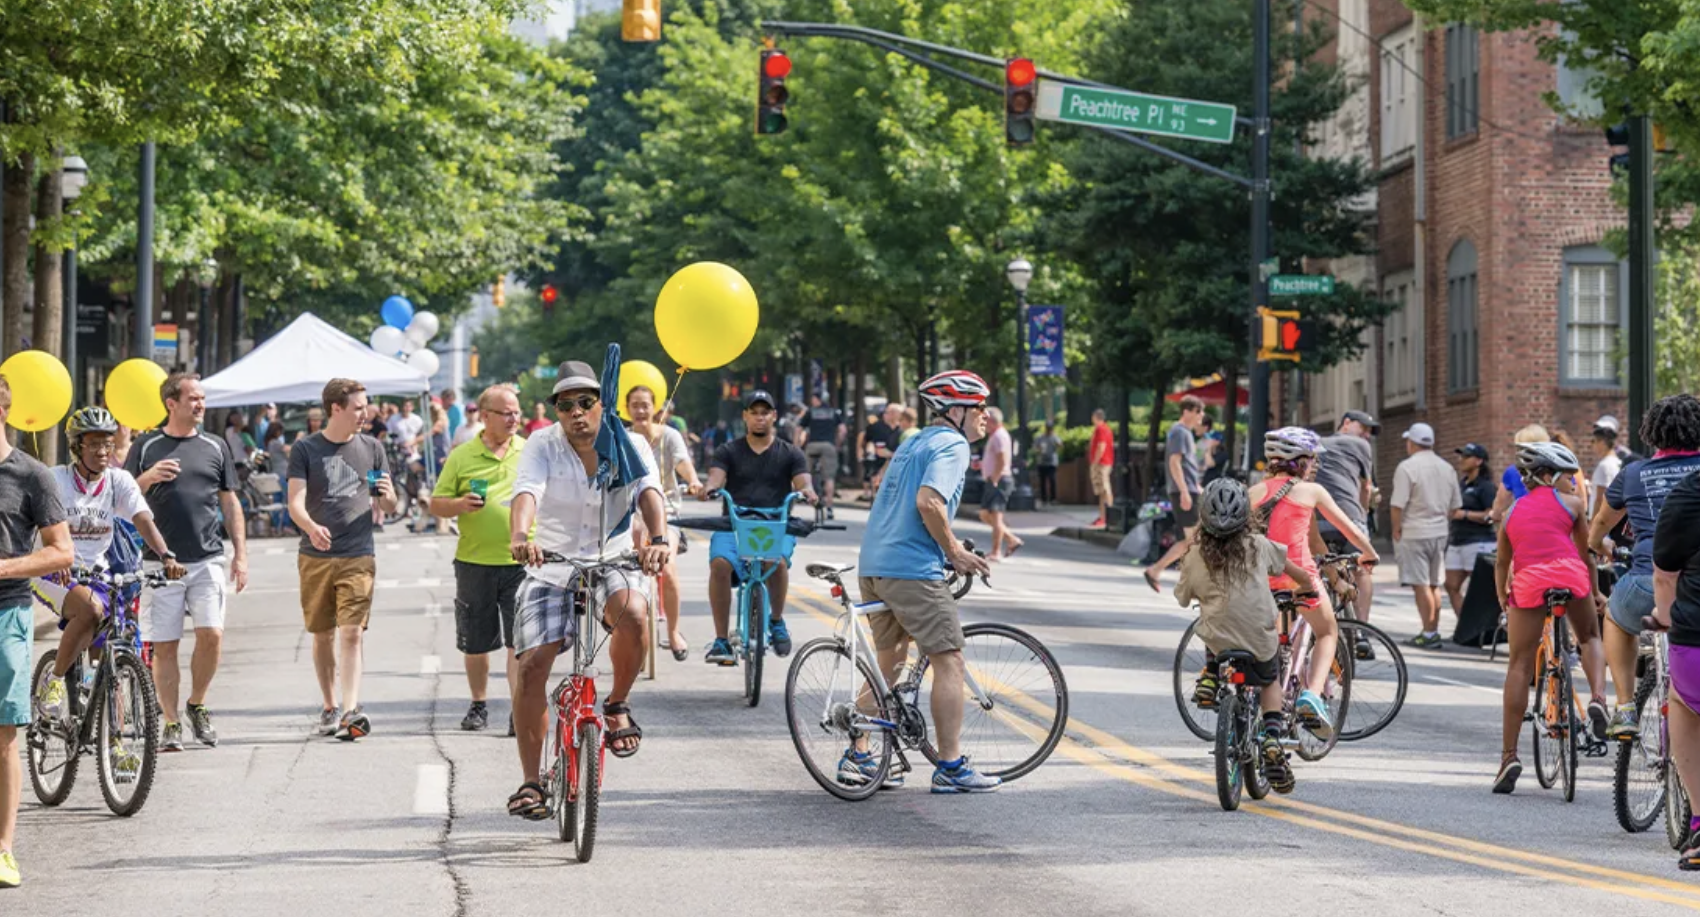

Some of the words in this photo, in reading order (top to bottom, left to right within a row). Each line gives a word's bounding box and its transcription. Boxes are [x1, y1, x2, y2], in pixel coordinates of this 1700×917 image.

[1069, 94, 1140, 122] Peachtree
[1172, 104, 1188, 117] NE
[1170, 119, 1186, 132] 93
[1273, 278, 1319, 290] Peachtree
